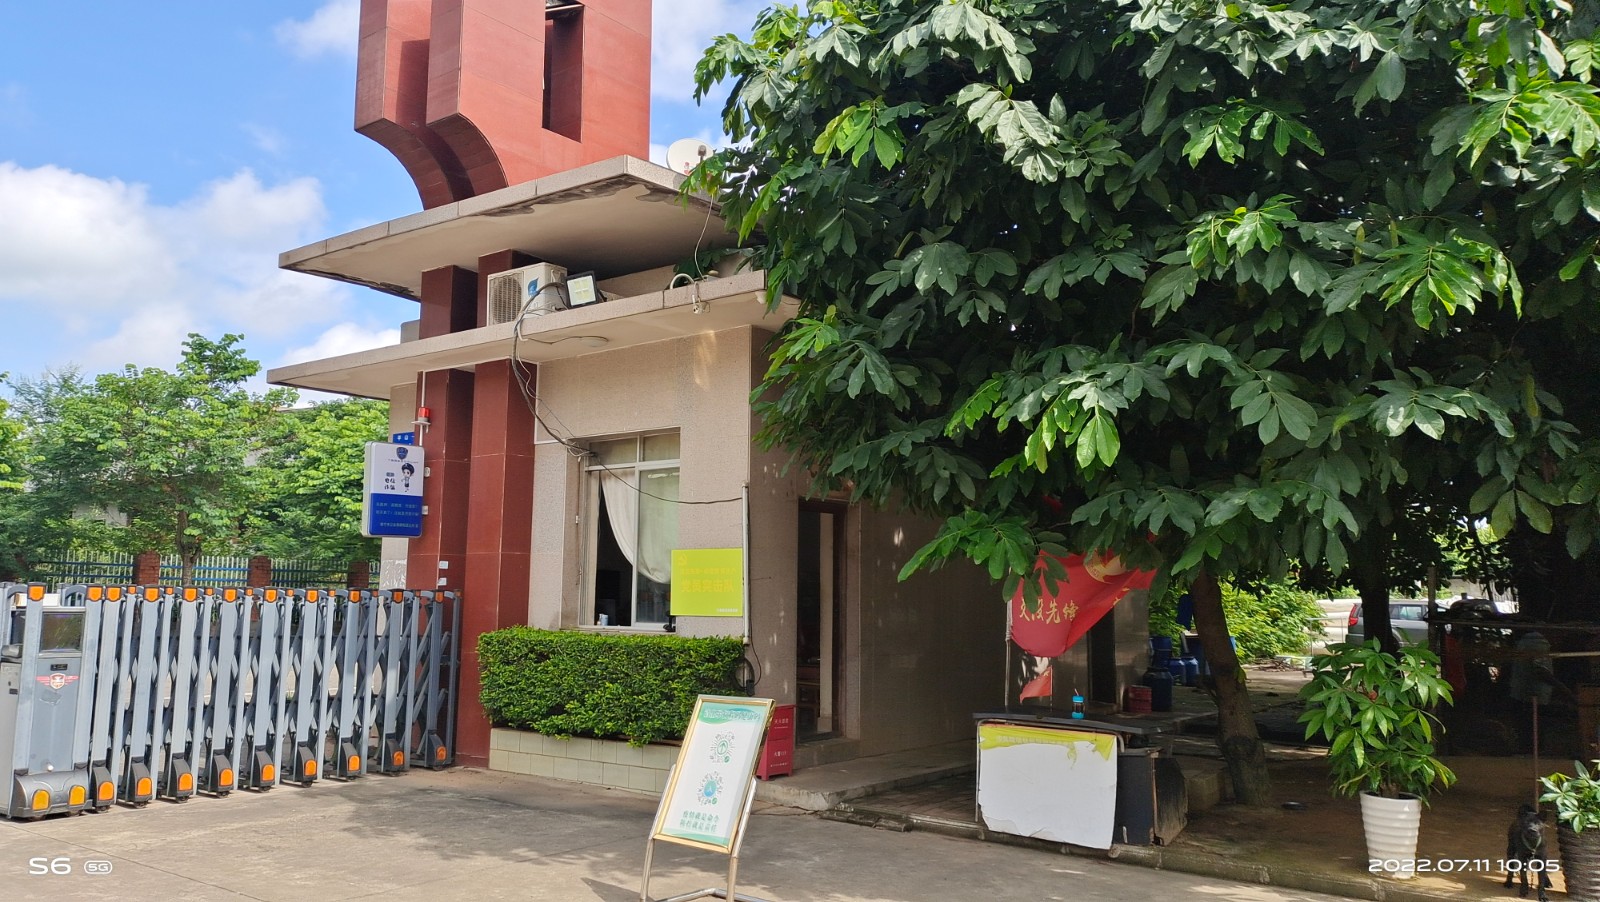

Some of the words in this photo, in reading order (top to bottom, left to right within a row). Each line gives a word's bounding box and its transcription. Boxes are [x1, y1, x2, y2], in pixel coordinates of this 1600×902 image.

[682, 810, 720, 823] 疫情就是命令
